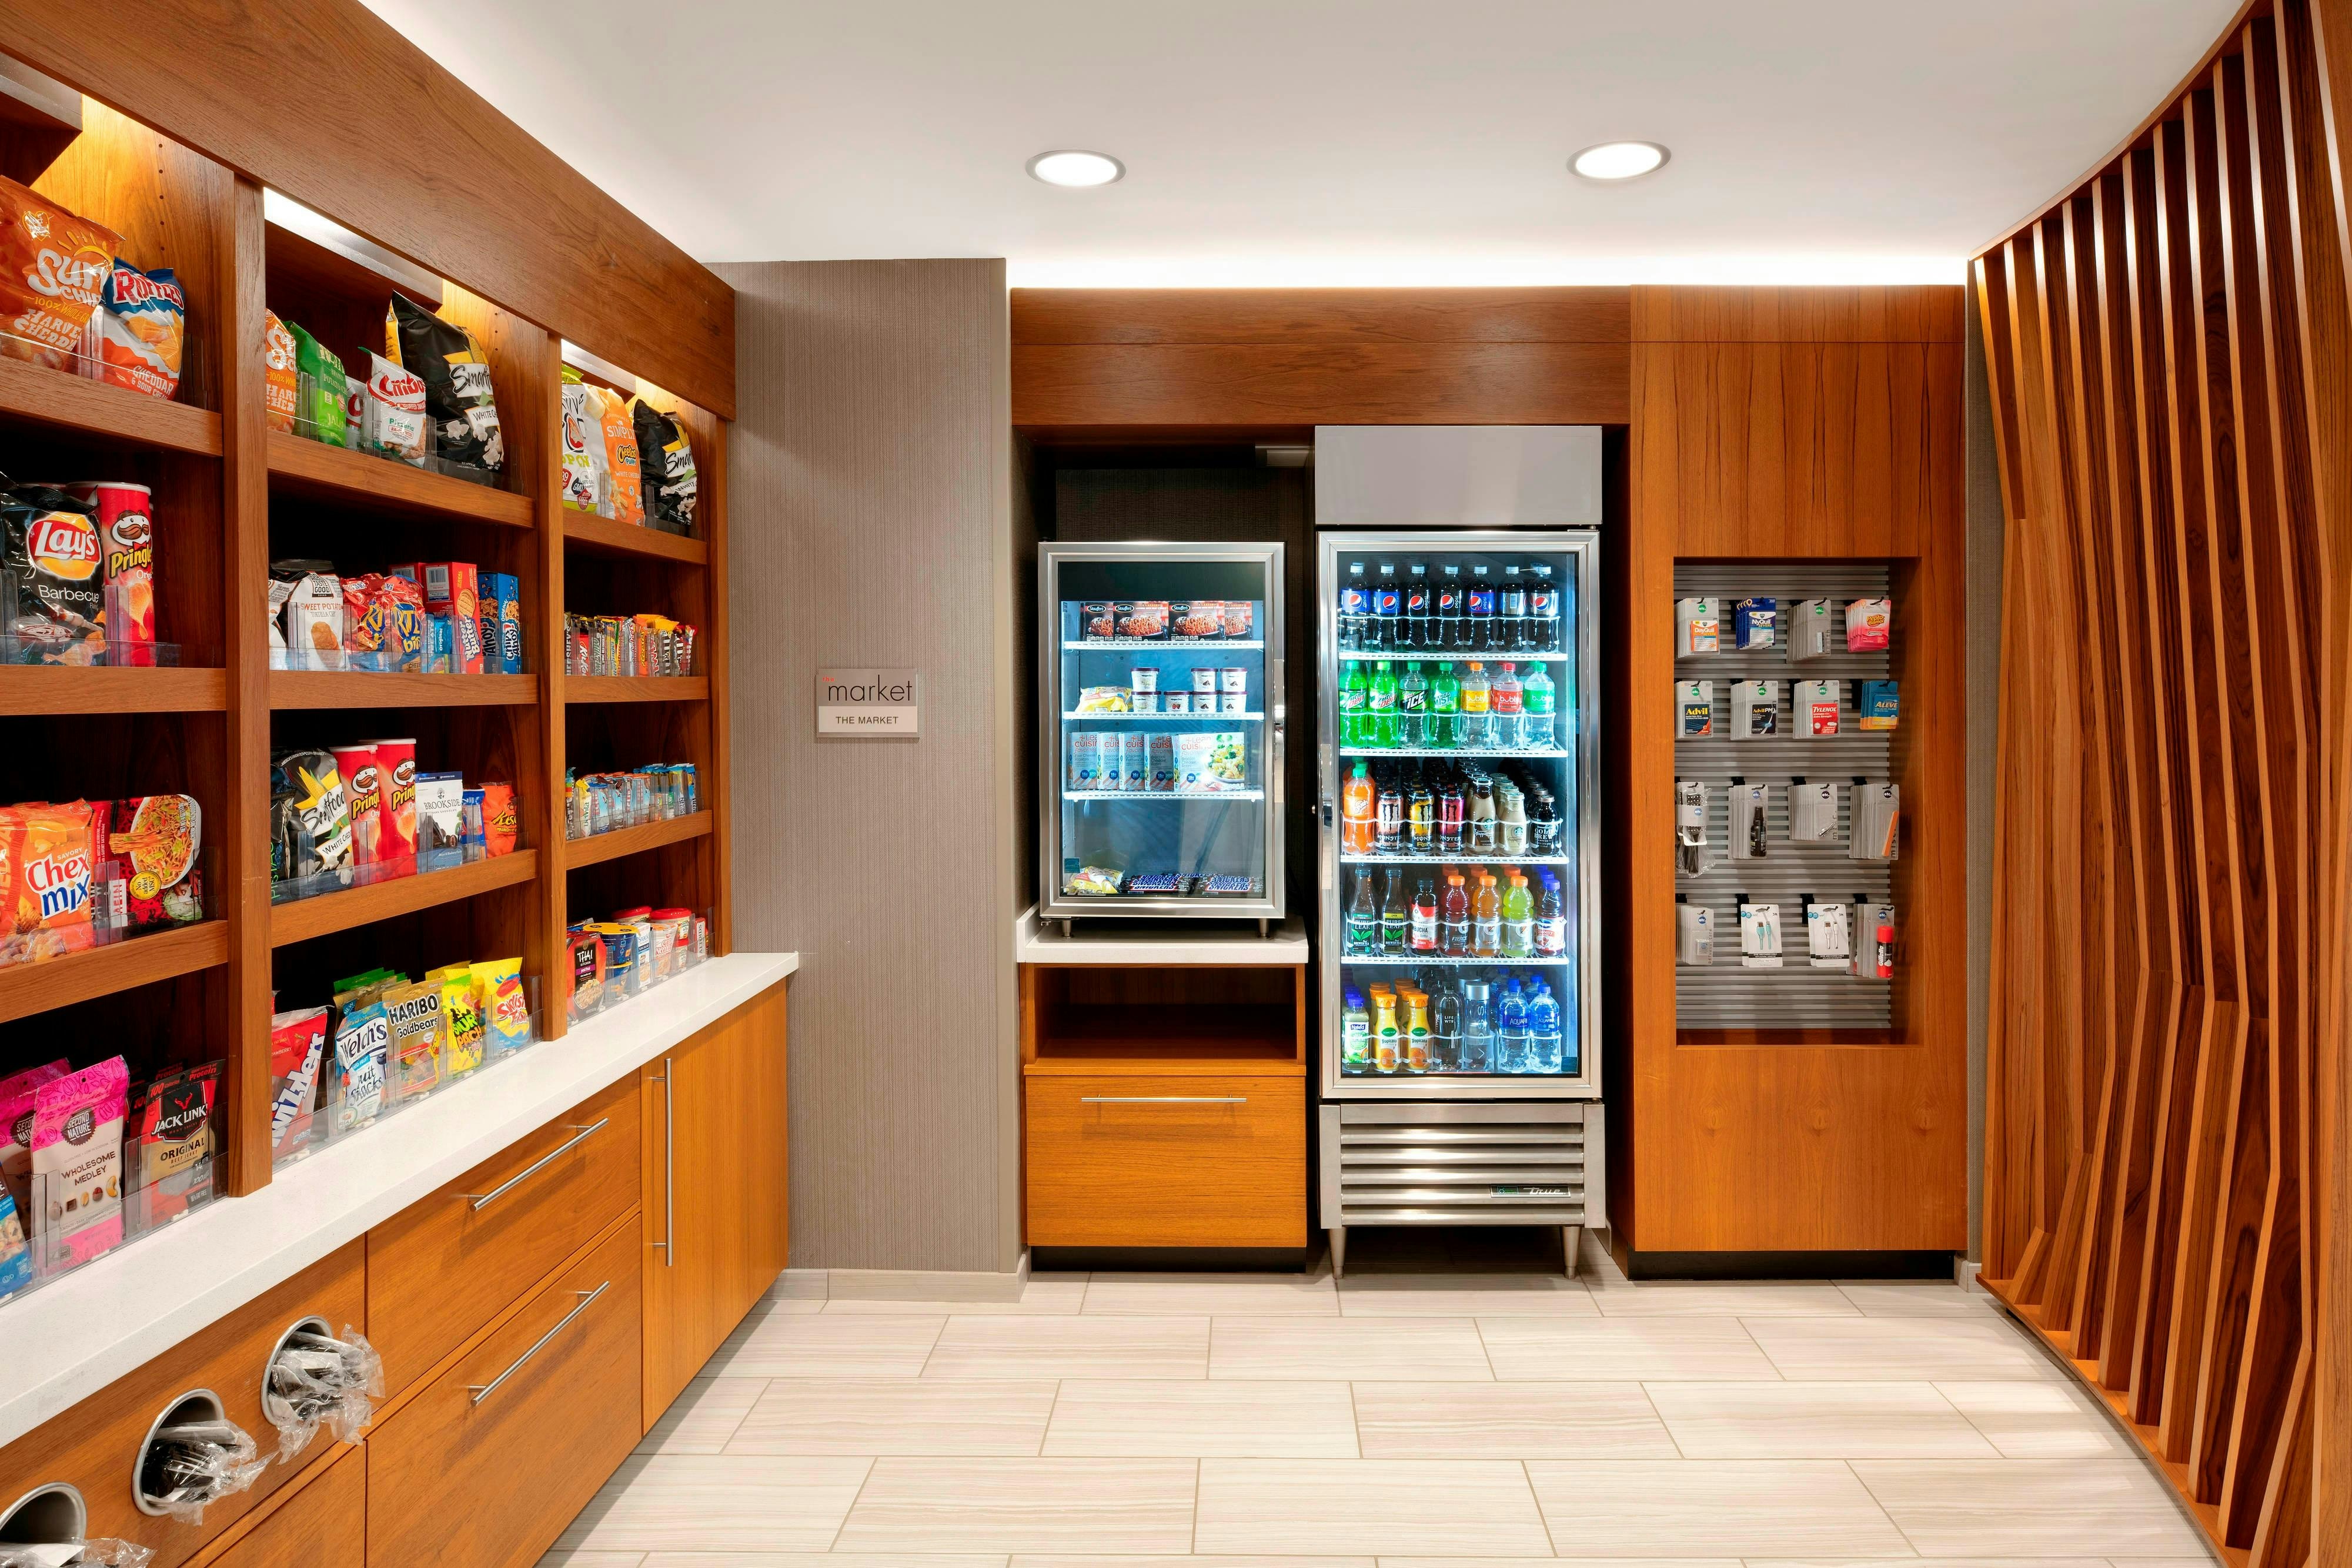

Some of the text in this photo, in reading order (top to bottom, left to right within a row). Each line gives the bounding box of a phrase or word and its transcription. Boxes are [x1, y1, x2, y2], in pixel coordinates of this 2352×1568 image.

[133, 365, 173, 395] CHEDDAR
[137, 380, 152, 394] SOUR
[473, 410, 490, 422] WHITE
[573, 482, 583, 492] GMO
[579, 496, 589, 506] FREE
[35, 521, 96, 560] Lay's
[38, 584, 99, 603] Barbecue
[460, 621, 475, 661] Nutter
[466, 616, 480, 654] Butter
[828, 674, 912, 701] market
[1406, 691, 1425, 710] ICE
[1434, 696, 1451, 706] MIST
[424, 798, 461, 810] BROOKSIDE
[57, 847, 82, 861] SAVORY
[323, 838, 342, 854] WHITE
[28, 850, 90, 892] Chex
[135, 881, 142, 890] No
[42, 874, 90, 917] mix
[577, 950, 593, 963] THAI
[389, 994, 439, 1025] HARIBO
[397, 1017, 437, 1038] Goldbears
[456, 1026, 482, 1048] PATCH
[340, 1024, 387, 1064] Welch's
[189, 1067, 217, 1082] Protein
[150, 1082, 165, 1099] 100
[68, 1111, 89, 1129] SECOND
[152, 1115, 183, 1135] JACK
[68, 1122, 91, 1141] NATURE
[160, 1137, 205, 1162] ORIGINAL
[171, 1149, 198, 1164] BEEF JERKY
[61, 1151, 116, 1179] WHOLESOME
[75, 1165, 107, 1185] MEDLEY
